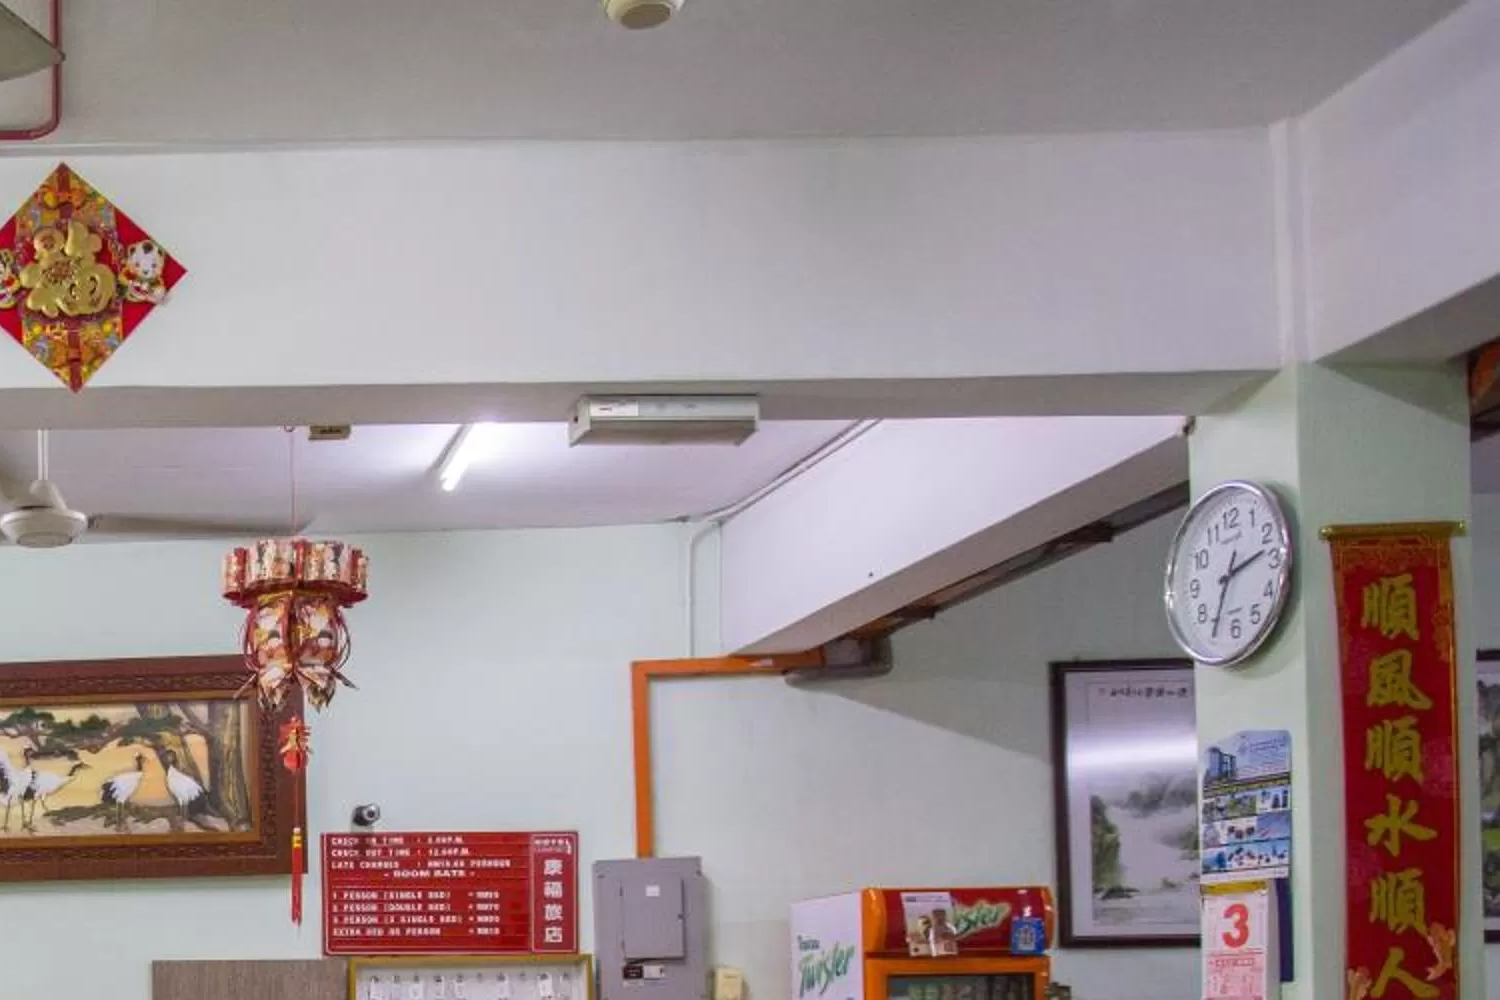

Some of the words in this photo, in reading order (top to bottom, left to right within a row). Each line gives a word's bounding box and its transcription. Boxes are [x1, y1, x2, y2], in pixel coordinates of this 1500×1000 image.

[1222, 507, 1240, 529] 12
[1249, 508, 1256, 528] 1
[1207, 523, 1220, 545] 11
[1261, 522, 1273, 544] 2
[1193, 549, 1210, 570] 10
[1268, 548, 1281, 569] 3
[1189, 578, 1200, 599] 9
[1263, 580, 1273, 599] 4
[1197, 603, 1208, 624] 8
[1250, 604, 1261, 625] 5
[1230, 618, 1242, 639] 6
[393, 869, 431, 878] ROOM
[433, 869, 466, 878] RATE
[343, 891, 378, 900] PERSON
[343, 903, 378, 912] PERSON
[343, 915, 379, 924] PERSON
[1221, 903, 1249, 949] 3
[333, 928, 361, 937] EXTRA
[406, 928, 441, 937] PERSON
